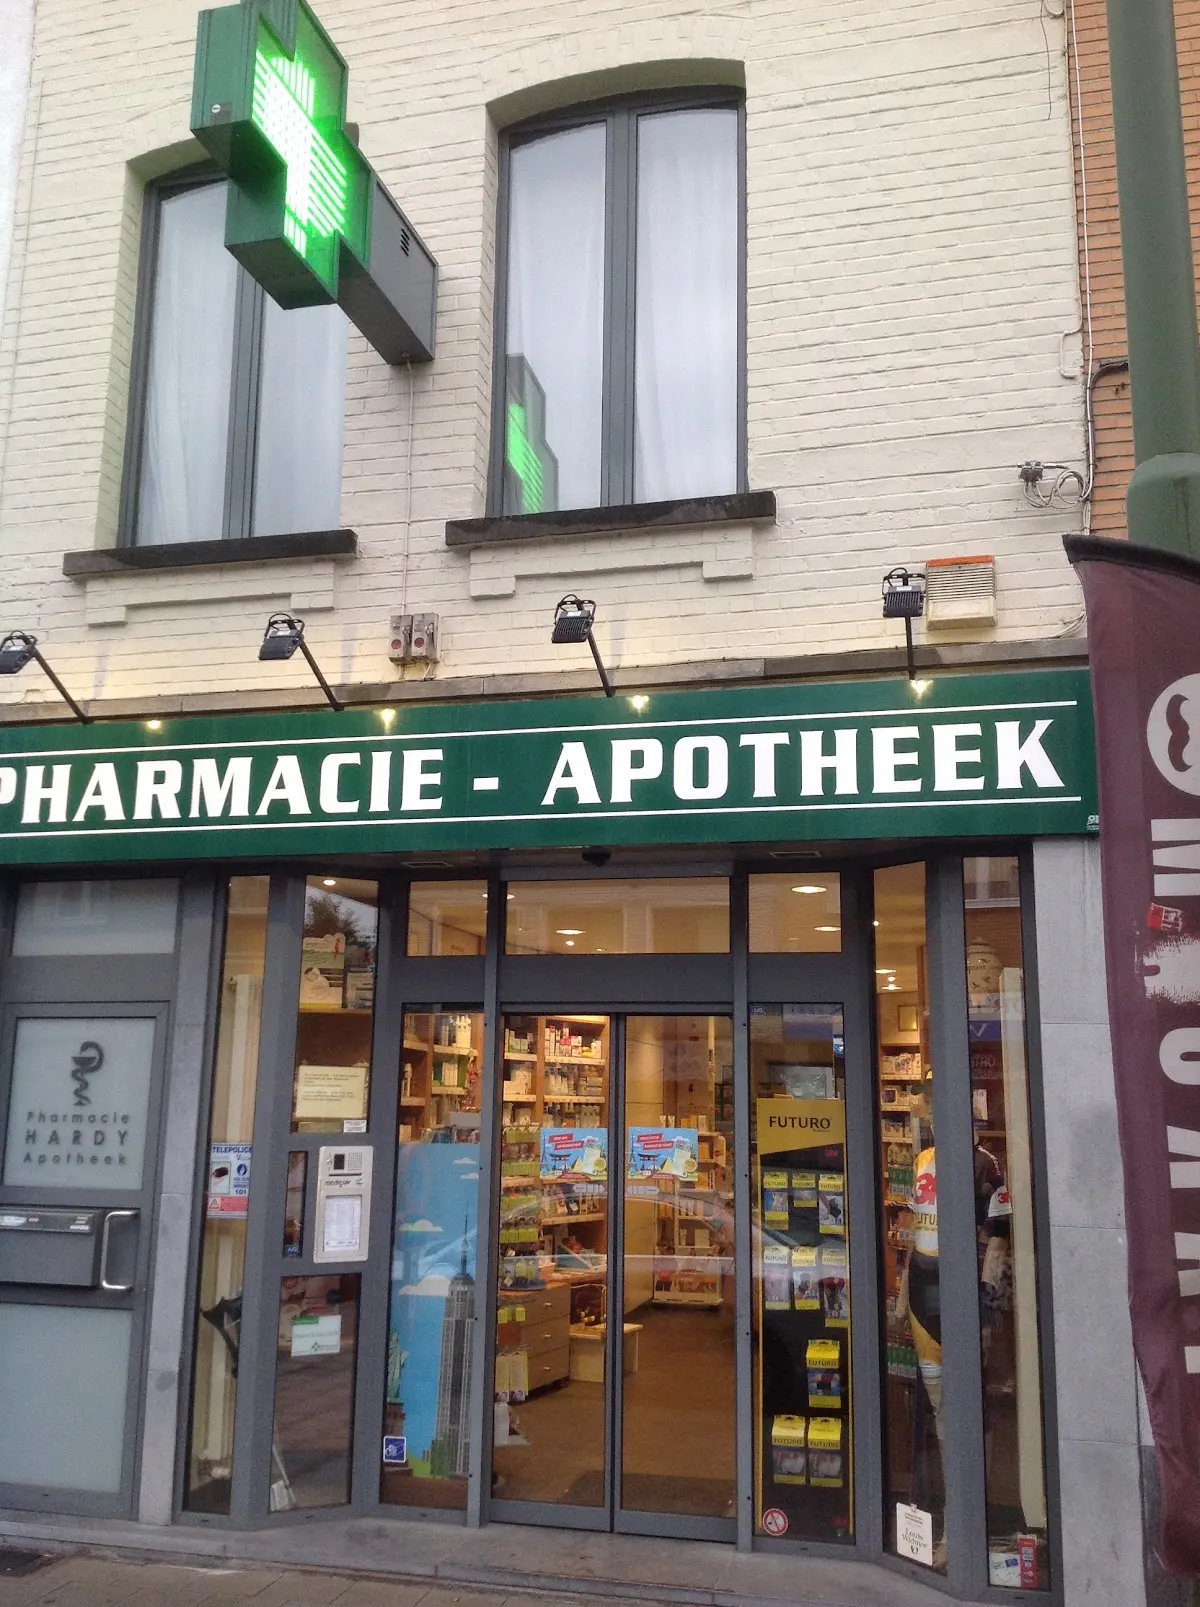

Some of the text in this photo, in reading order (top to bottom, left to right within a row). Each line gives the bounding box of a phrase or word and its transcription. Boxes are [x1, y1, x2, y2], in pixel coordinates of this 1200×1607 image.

[540, 719, 1066, 806] APOTHEEK
[26, 1111, 130, 1124] Pharmacie
[769, 1116, 831, 1129] FUTURO
[25, 1129, 128, 1146] HARDY
[23, 1152, 126, 1165] Apotheek
